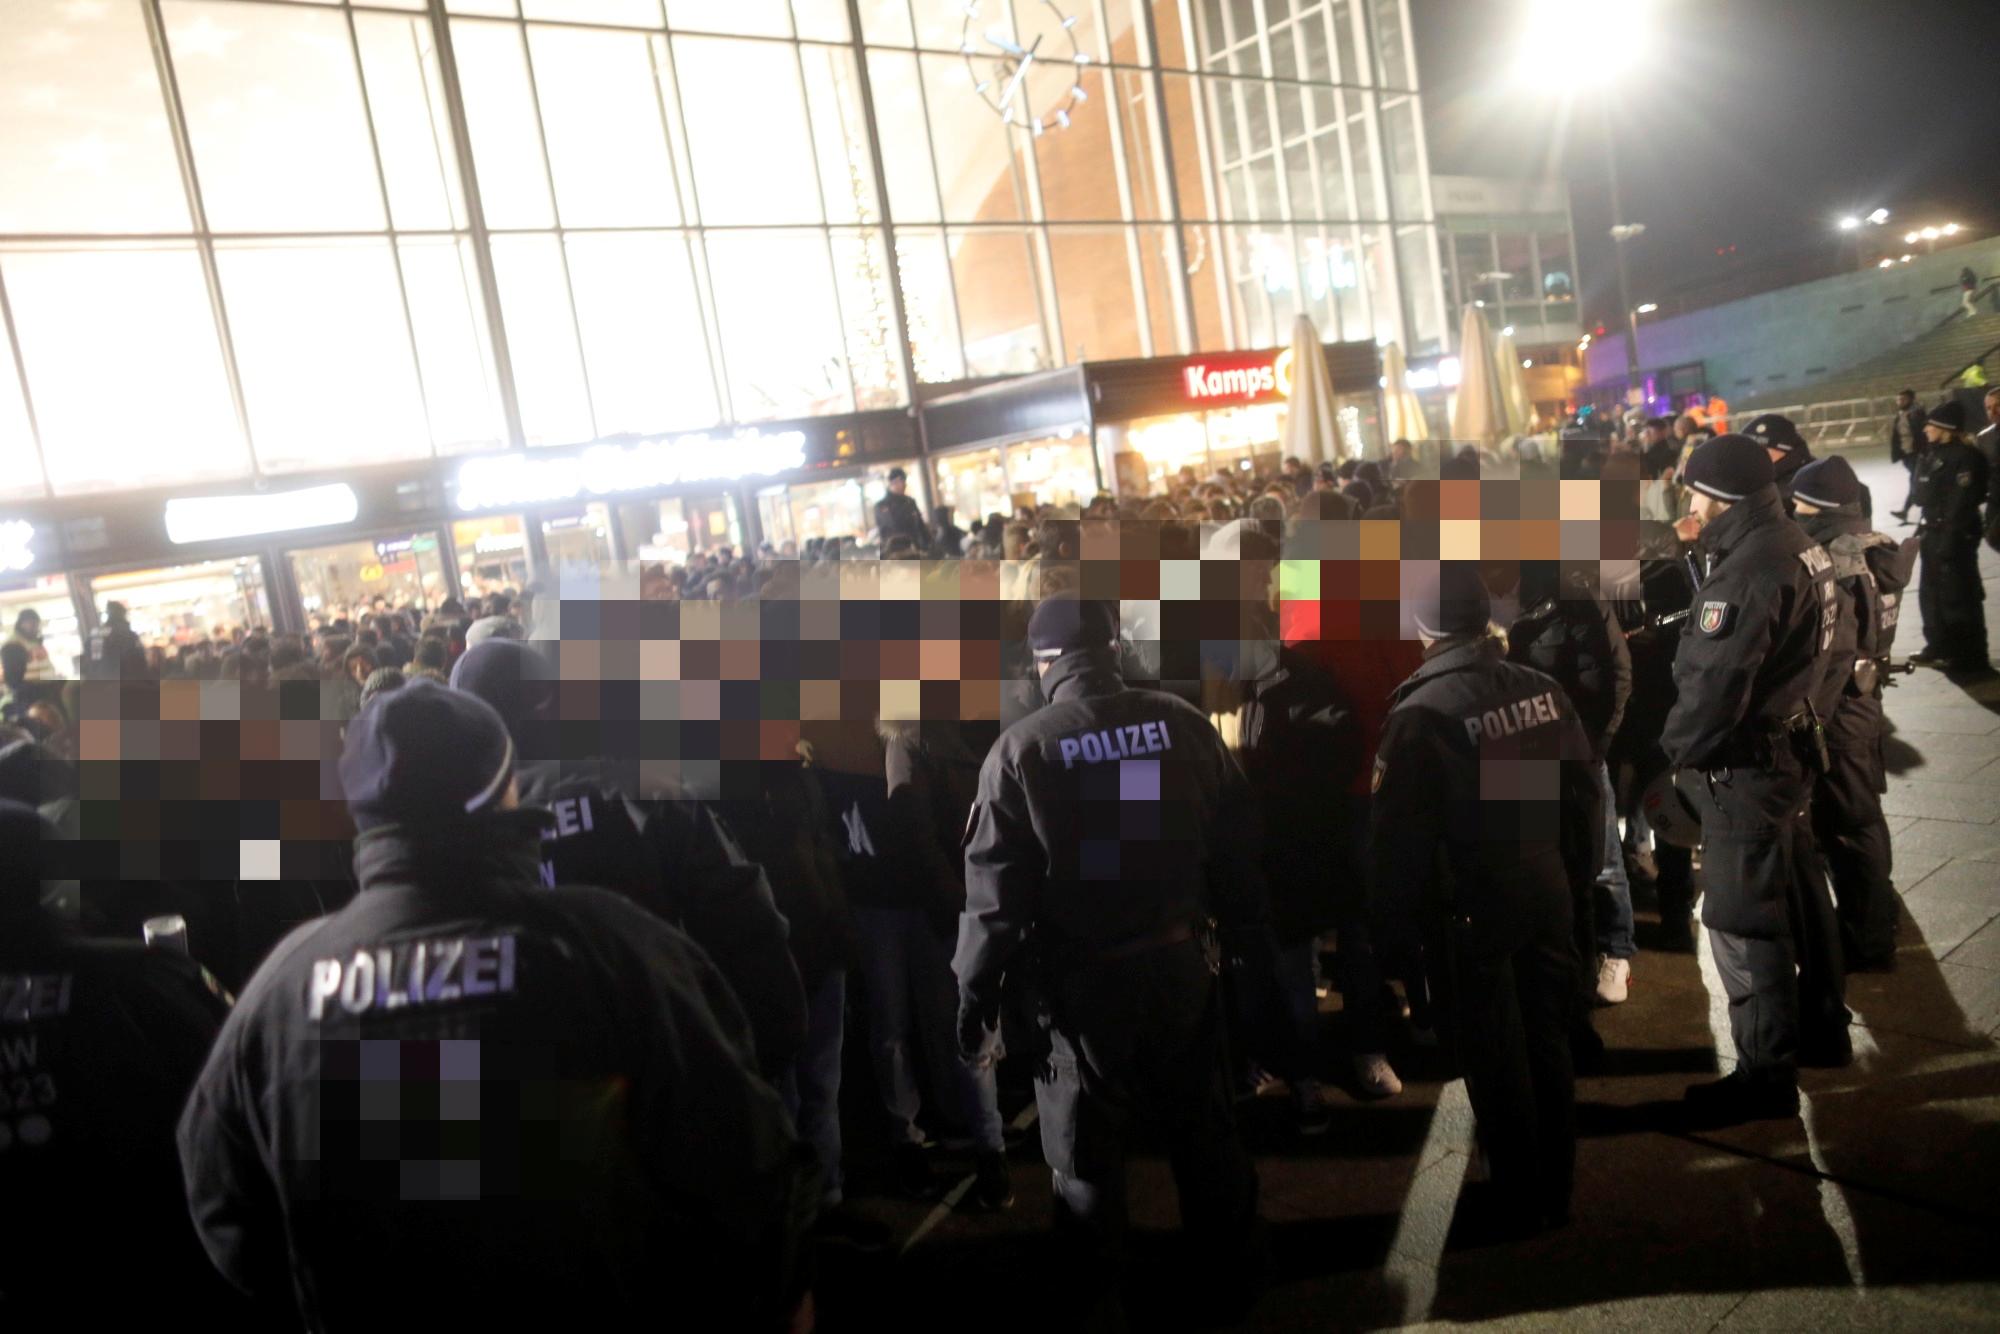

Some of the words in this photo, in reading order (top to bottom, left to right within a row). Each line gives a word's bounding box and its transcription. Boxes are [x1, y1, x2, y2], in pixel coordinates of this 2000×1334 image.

[1184, 365, 1275, 398] Kamps
[1464, 692, 1559, 746] POLIZEI
[1060, 720, 1172, 769] POLIZEI
[540, 796, 594, 840] EI
[309, 935, 516, 1021] POLIZEI
